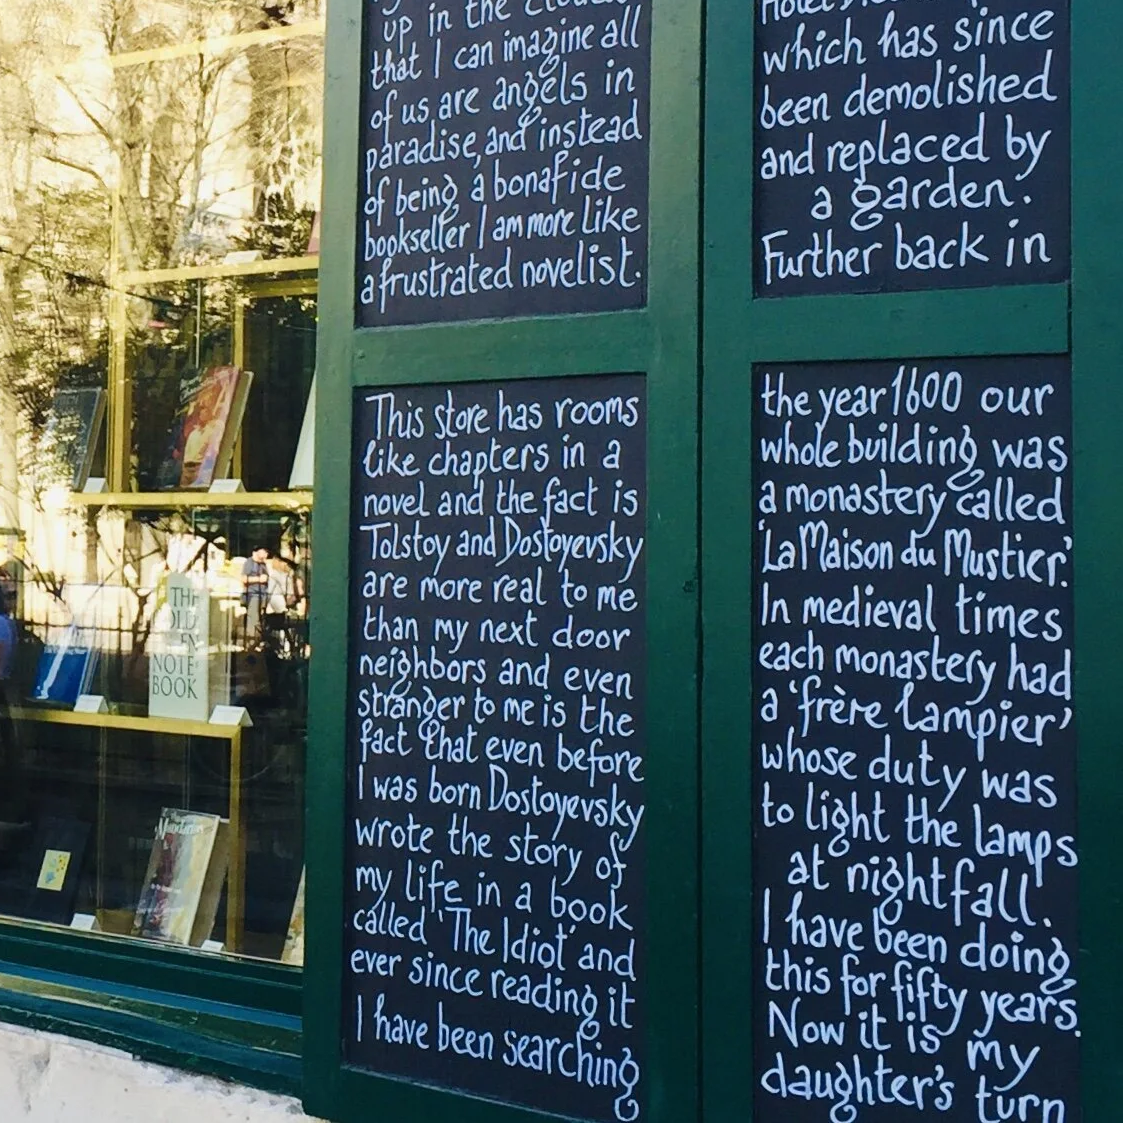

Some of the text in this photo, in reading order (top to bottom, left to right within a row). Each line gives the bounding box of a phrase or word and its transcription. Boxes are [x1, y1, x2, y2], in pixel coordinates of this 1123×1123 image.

[384, 16, 412, 54] up
[429, 4, 452, 37] in
[760, 49, 1057, 129] been demolished
[366, 98, 642, 194] paradise, and instead
[361, 236, 641, 313] a frustrated novelist.
[762, 219, 1051, 285] Further back in
[365, 390, 639, 440] This store has rooms
[761, 365, 1054, 431] the year 1600 our
[363, 434, 621, 489] like chapters in a
[761, 420, 1068, 491] whole building was
[360, 516, 643, 584] Tolstoy and Dostoyevsky
[762, 582, 1062, 641] In medieval times
[152, 675, 198, 699] BOOK
[359, 645, 633, 701] neighbors and even
[759, 630, 1071, 705] each monastery had
[355, 813, 627, 889] wrote the story of
[357, 993, 639, 1122] I have been searching
[769, 997, 1040, 1090] Now it is my
[761, 1052, 1064, 1123] daughter's turn
